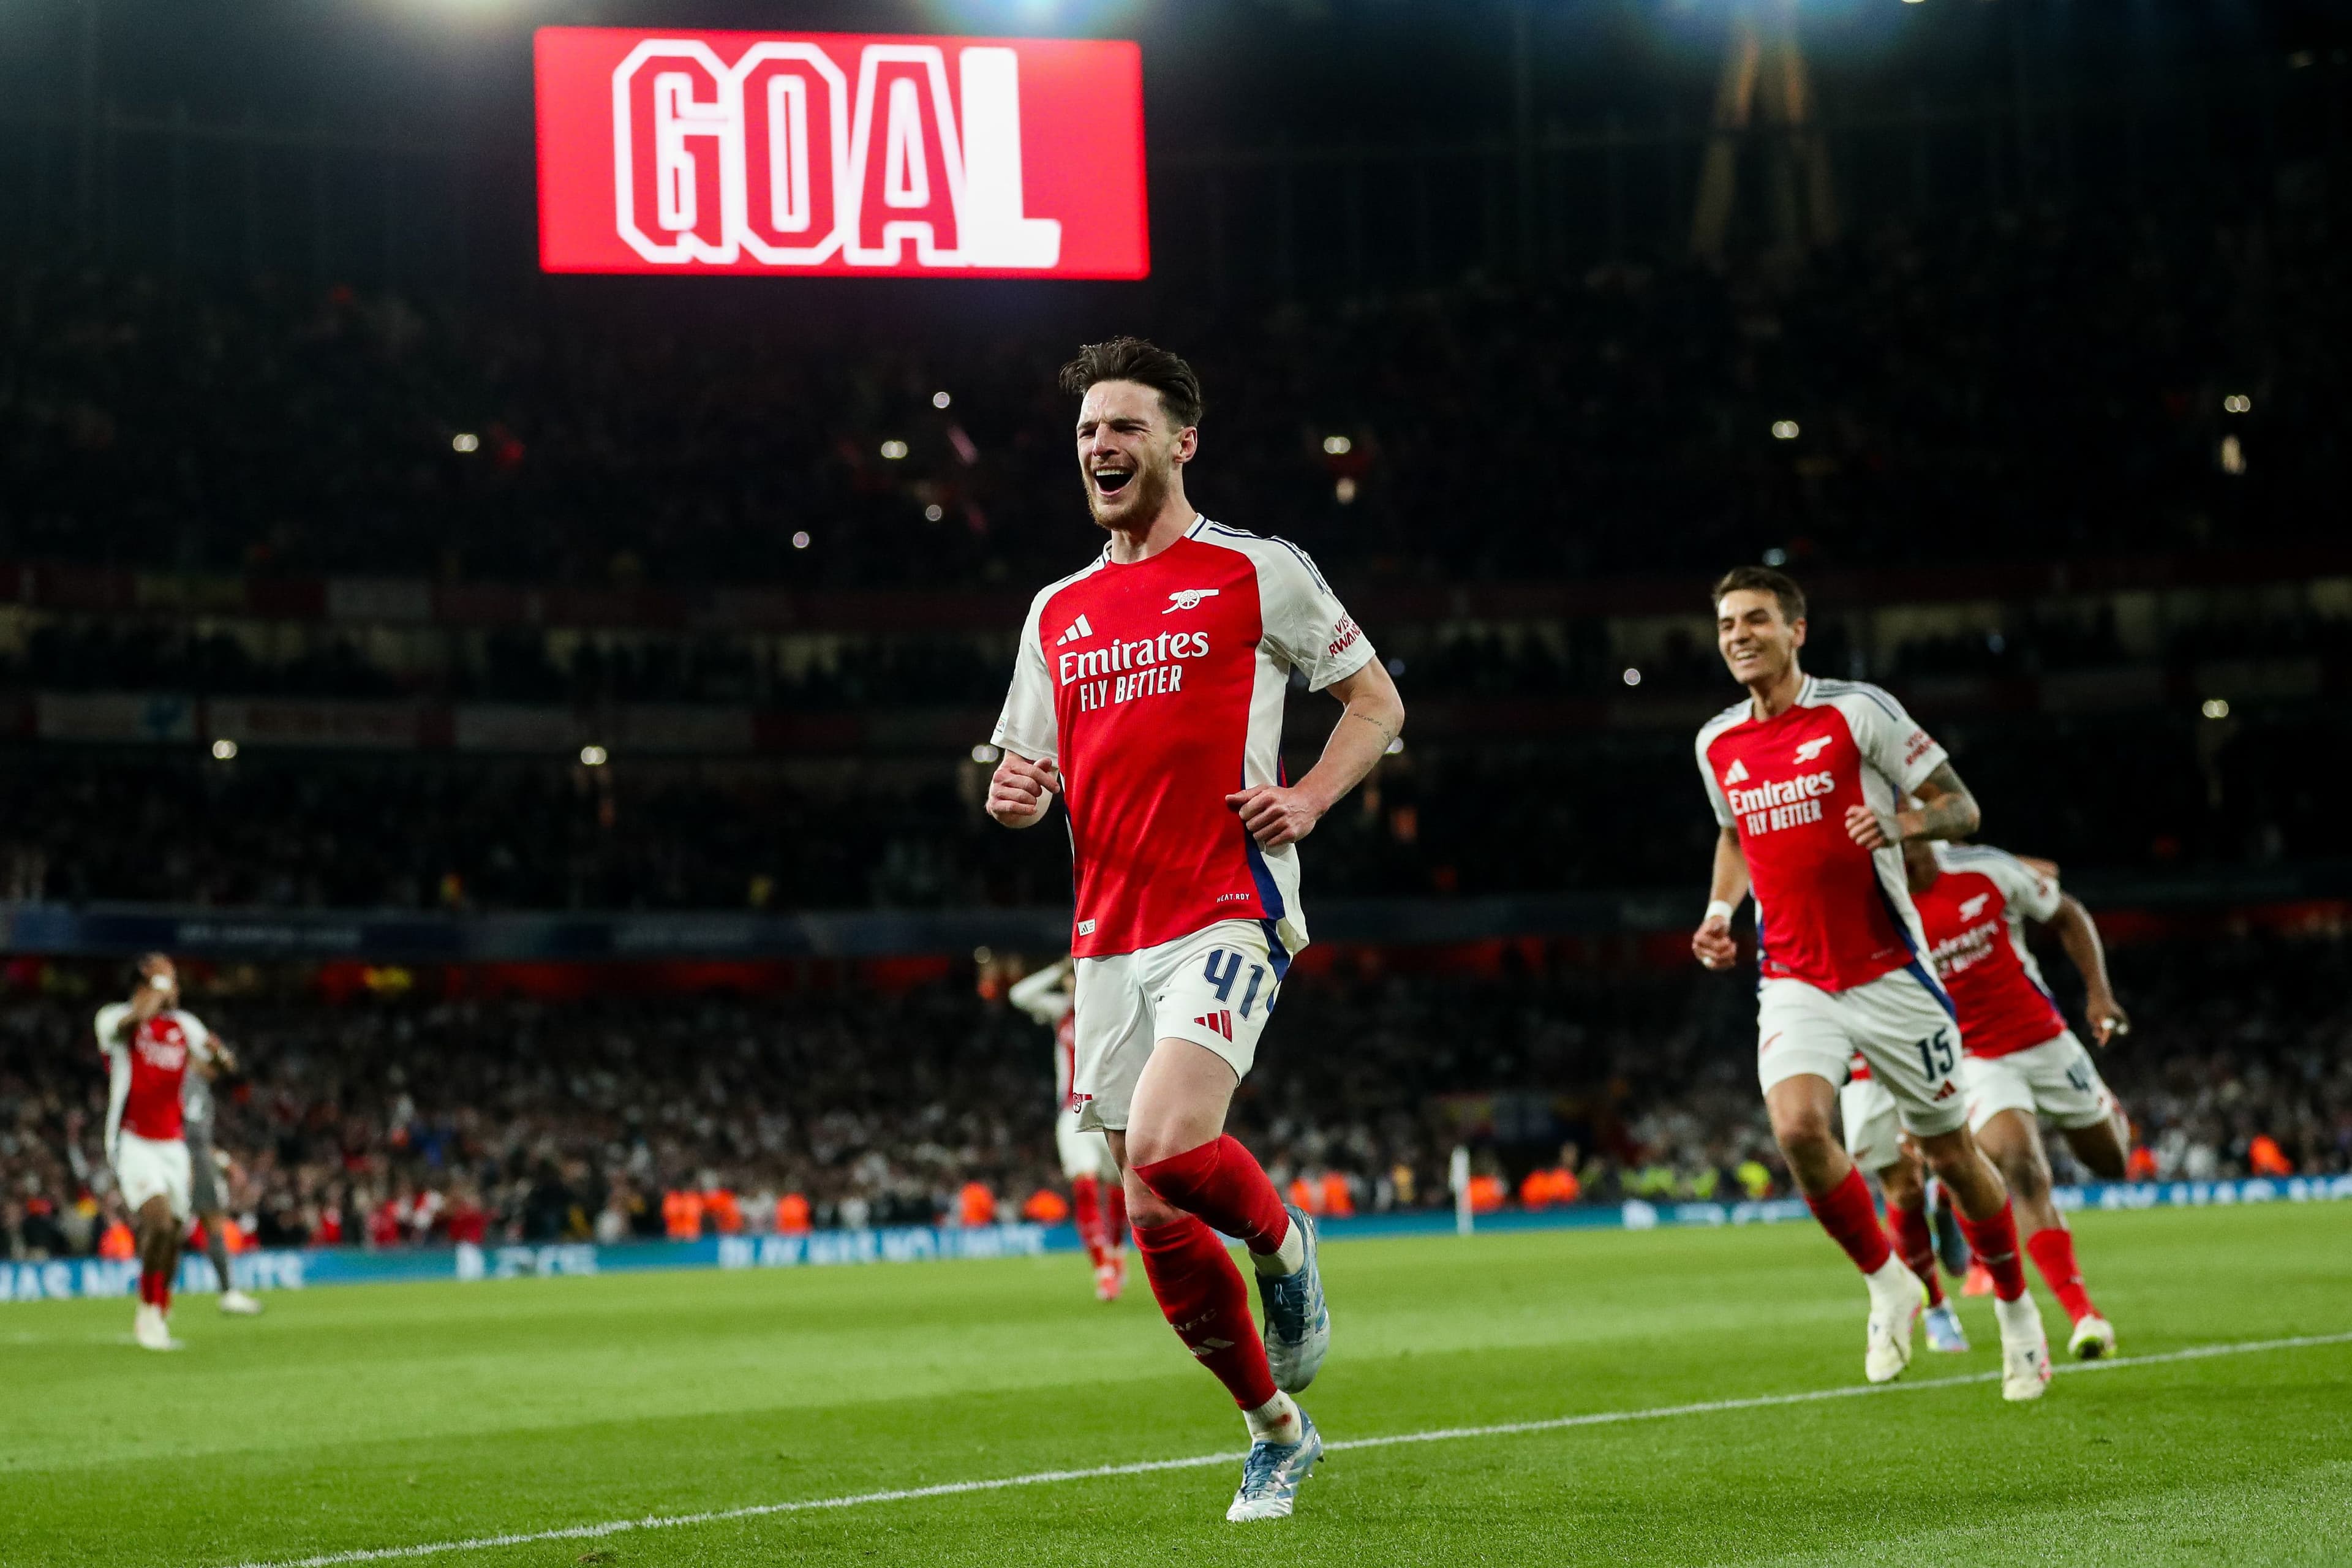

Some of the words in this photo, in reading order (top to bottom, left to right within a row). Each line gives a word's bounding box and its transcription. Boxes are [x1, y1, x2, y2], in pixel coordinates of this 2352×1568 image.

[612, 39, 1061, 268] GOAL
[1058, 630, 1210, 687] Emirates
[1328, 623, 1361, 658] RWAND
[1080, 679, 1108, 712] FLY
[1114, 665, 1182, 704] BETTER
[1728, 771, 1835, 816] Emirates
[1203, 949, 1265, 1021] 41
[1915, 1027, 1954, 1083] 15
